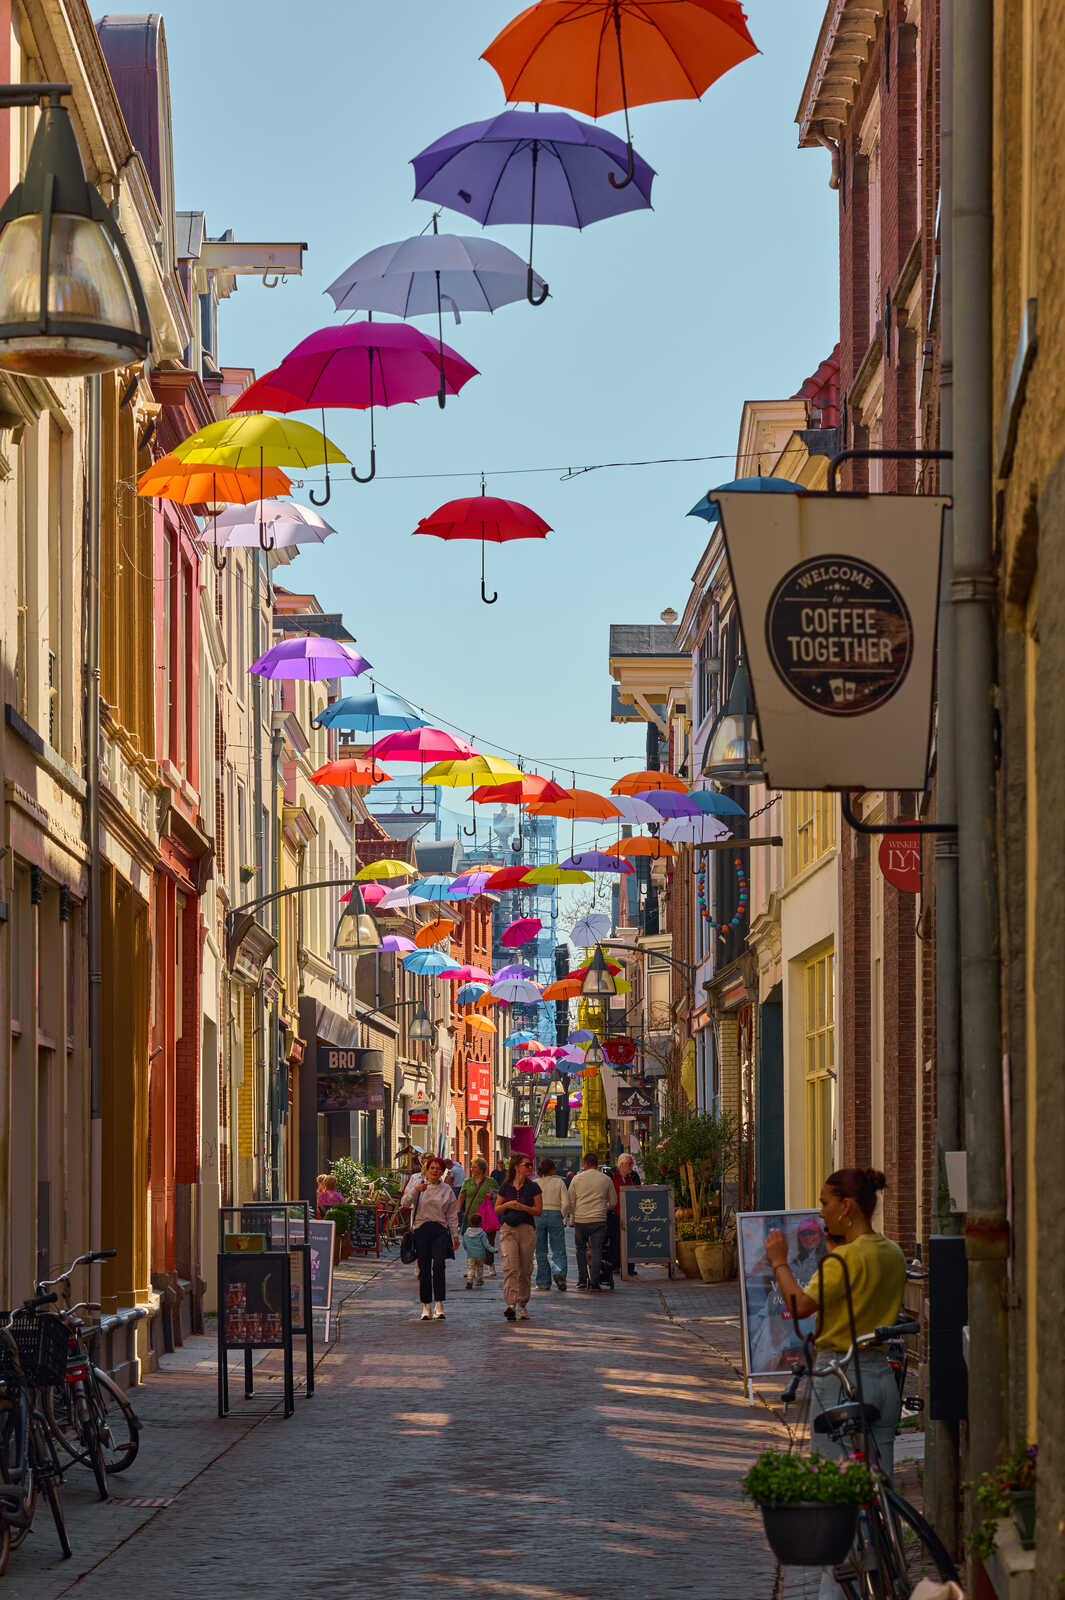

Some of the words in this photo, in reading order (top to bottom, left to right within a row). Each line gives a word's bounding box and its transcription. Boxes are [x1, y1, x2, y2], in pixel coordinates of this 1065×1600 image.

[798, 567, 873, 589] WELCOME
[801, 608, 877, 634] COFFEE
[787, 636, 893, 663] TOGETHER
[328, 1051, 356, 1069] BRO
